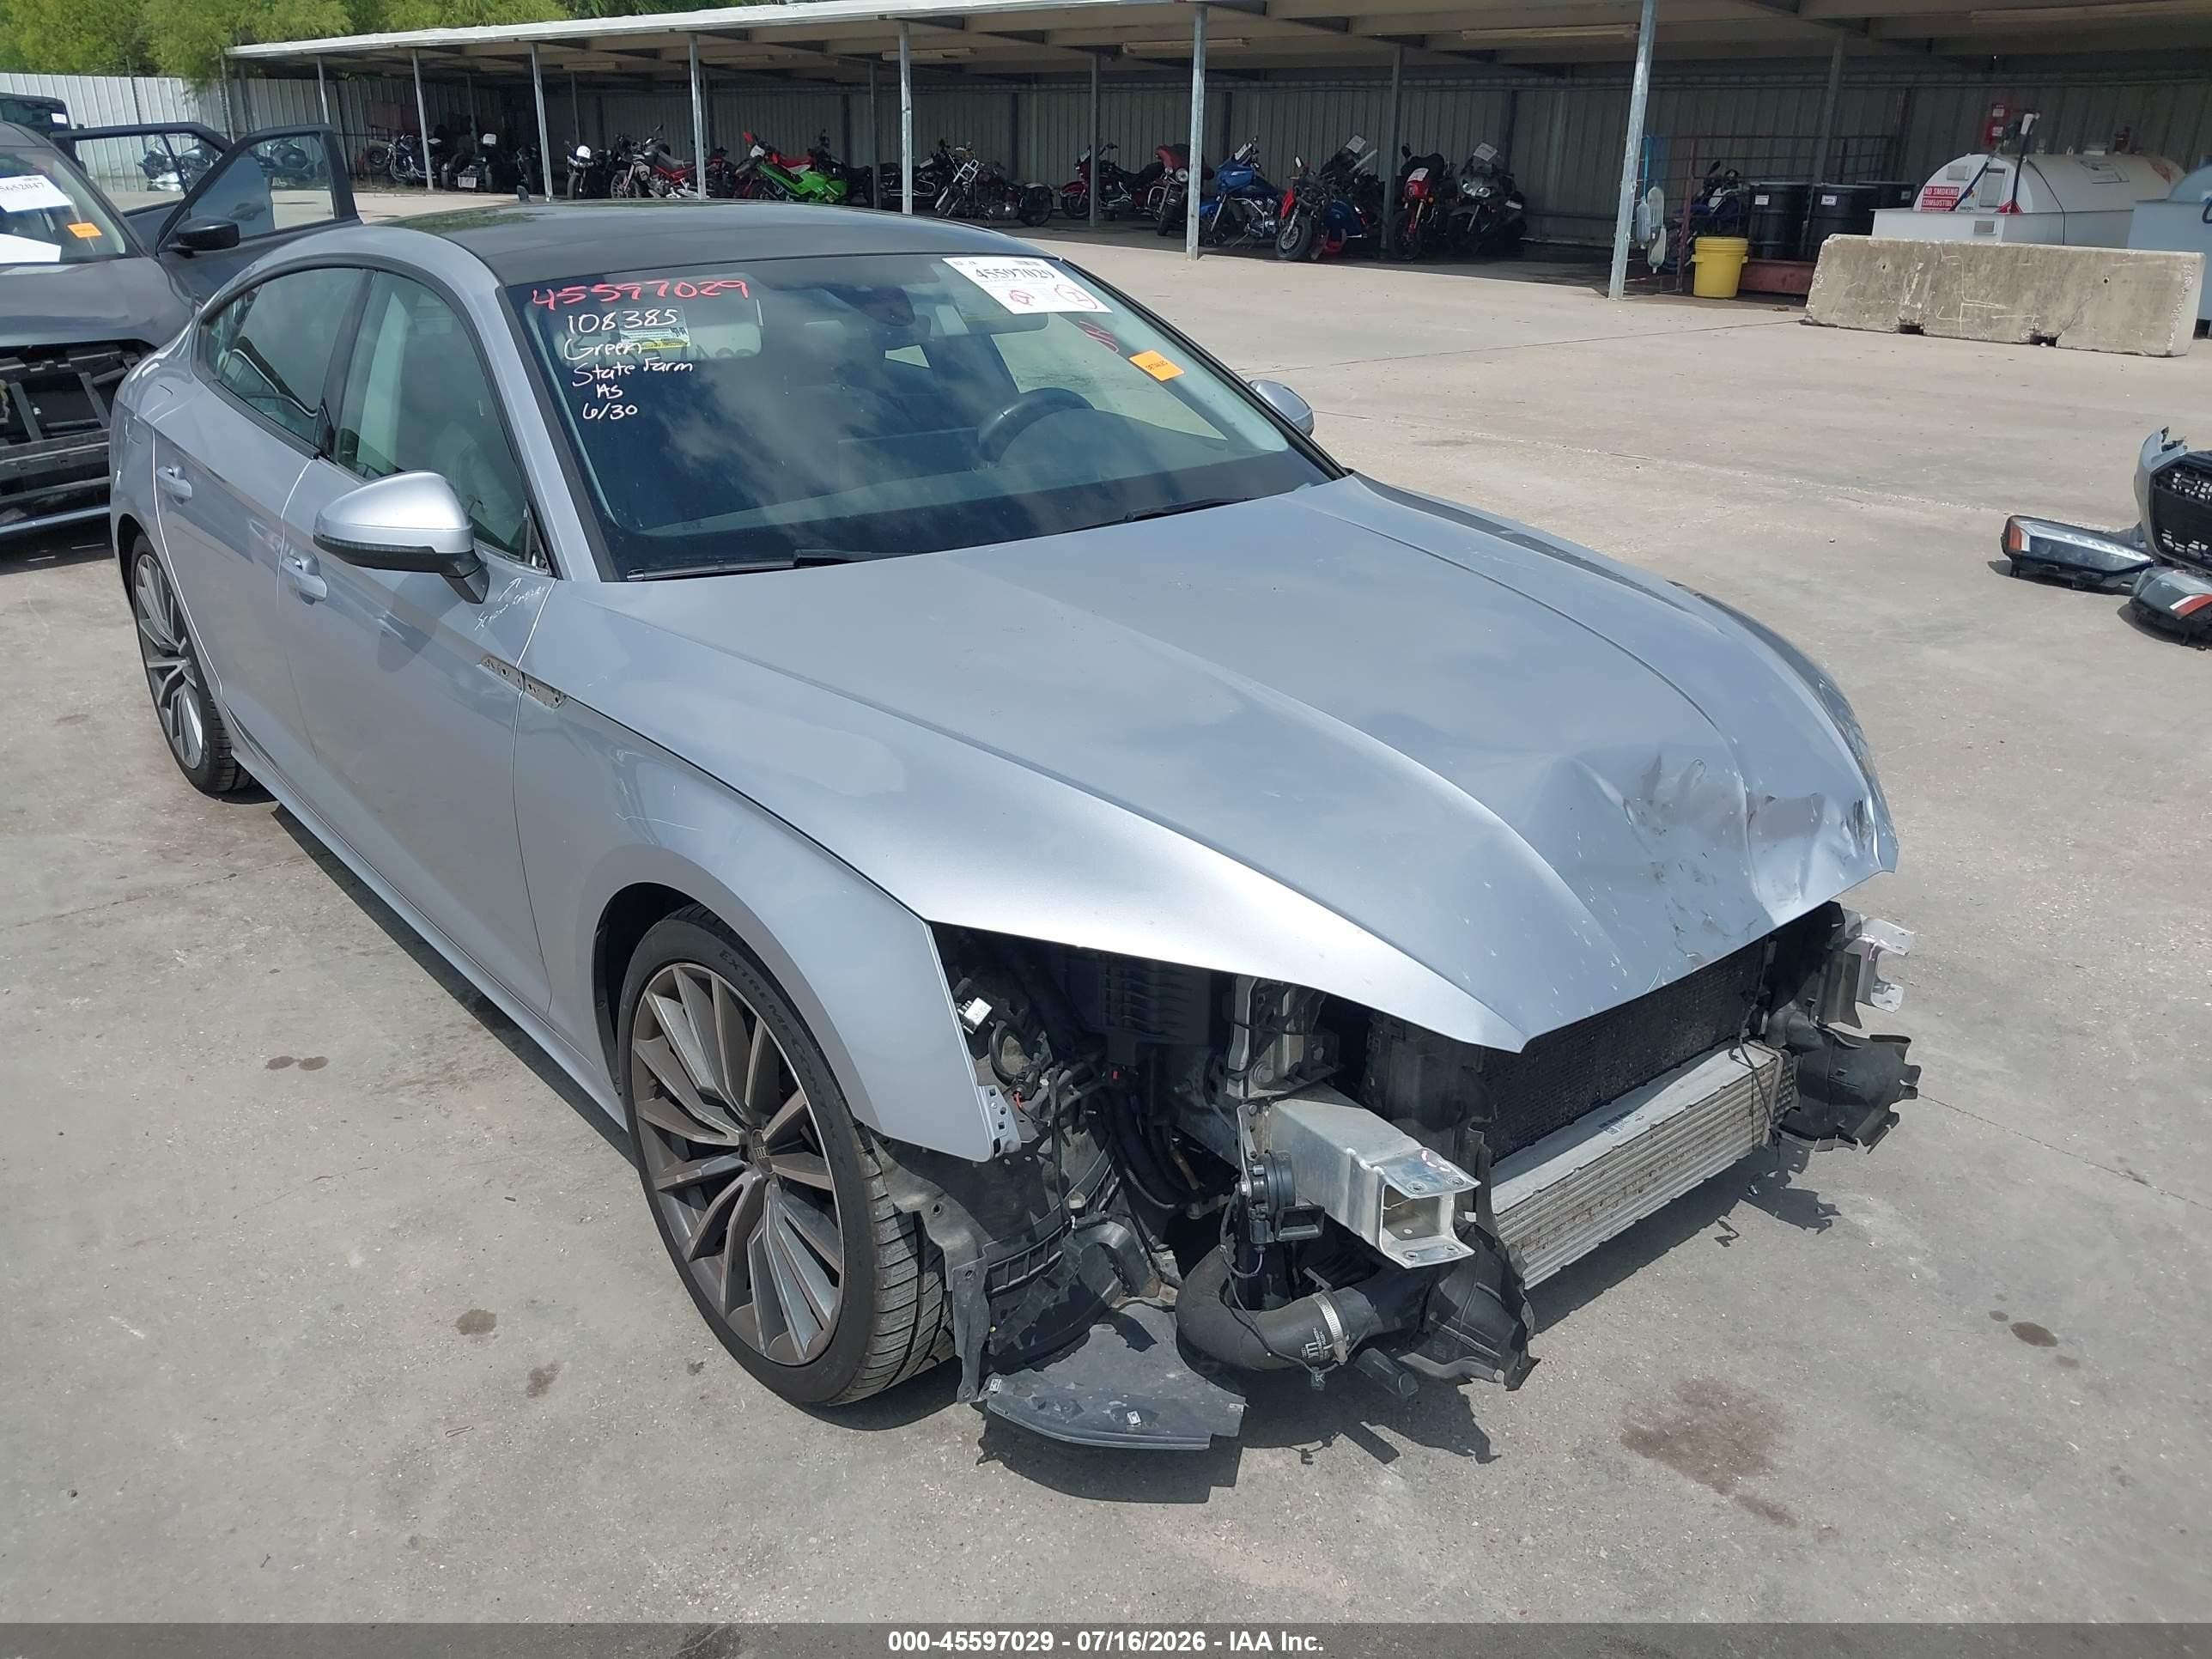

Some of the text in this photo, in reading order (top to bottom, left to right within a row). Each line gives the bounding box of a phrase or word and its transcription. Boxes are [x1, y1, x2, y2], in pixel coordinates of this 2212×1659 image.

[1923, 198, 1957, 207] COMBUSTIBL
[1934, 188, 1959, 197] SMOKING
[532, 280, 749, 311] 45597029
[568, 308, 678, 334] 108385
[563, 338, 642, 361] Green
[571, 356, 694, 387] State Farm
[582, 403, 639, 421] 6/30
